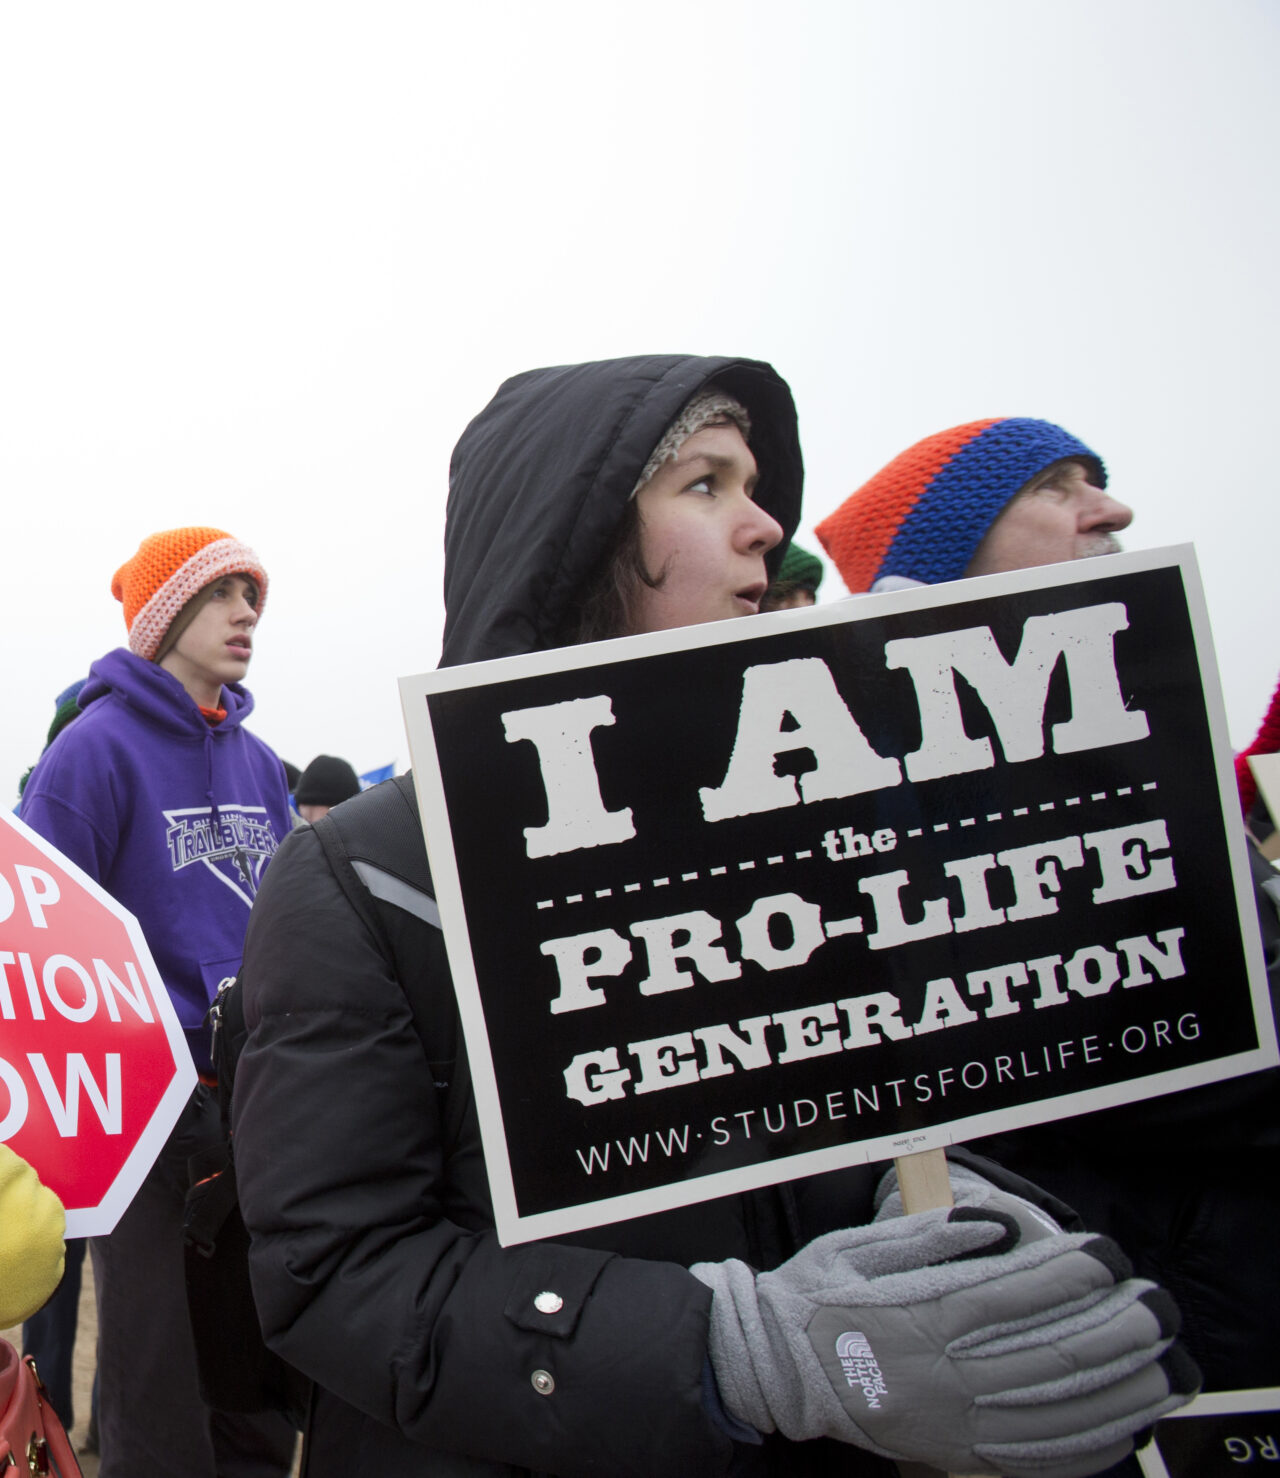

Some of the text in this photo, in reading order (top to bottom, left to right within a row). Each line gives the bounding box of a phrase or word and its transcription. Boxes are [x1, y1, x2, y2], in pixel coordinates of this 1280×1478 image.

[501, 602, 1151, 859] I AM
[822, 827, 898, 862] the
[540, 820, 1176, 1014] PRO-LIFE
[563, 928, 1186, 1106] GENERATION
[840, 1358, 860, 1387] THE
[853, 1358, 881, 1408] NORTH
[865, 1358, 888, 1394] FACE
